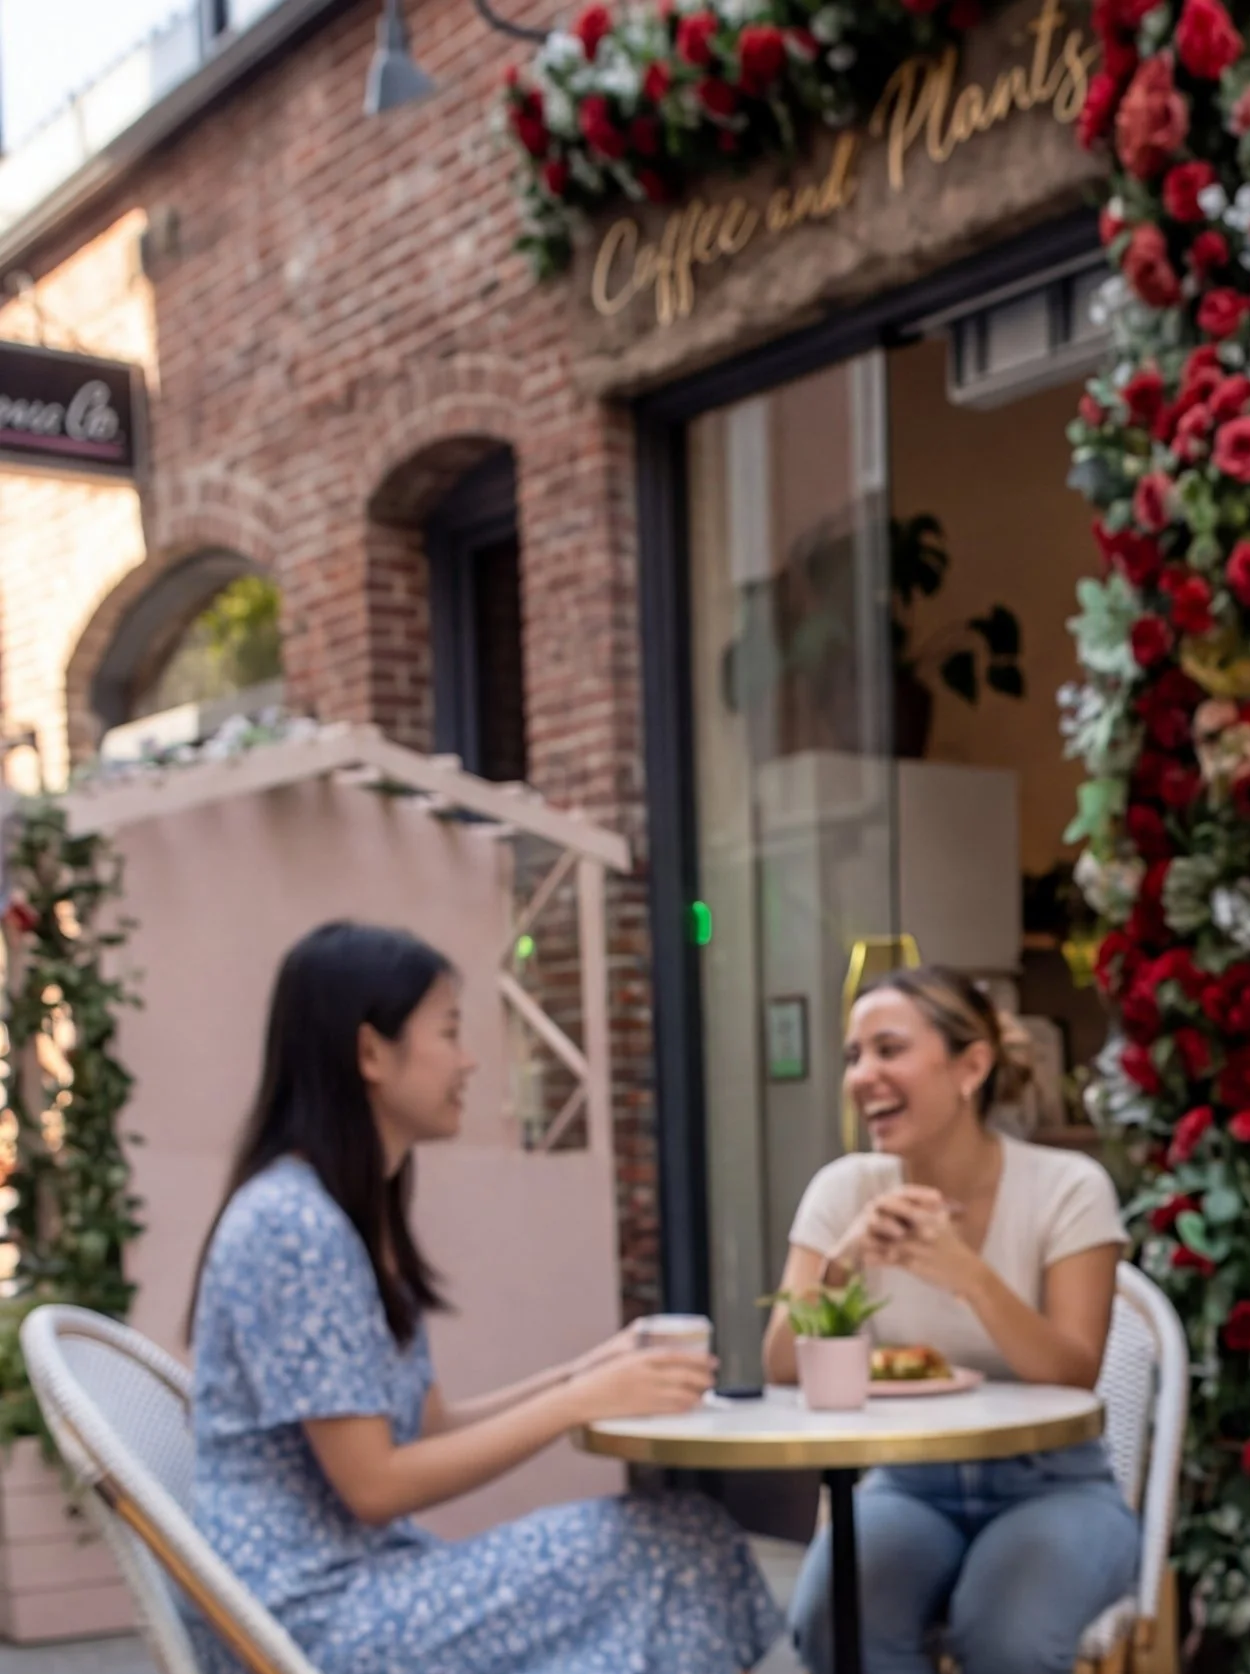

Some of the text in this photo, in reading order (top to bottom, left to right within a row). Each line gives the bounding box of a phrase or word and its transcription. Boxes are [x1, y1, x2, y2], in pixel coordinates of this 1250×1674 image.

[591, 0, 1102, 326] Coffee and Plants
